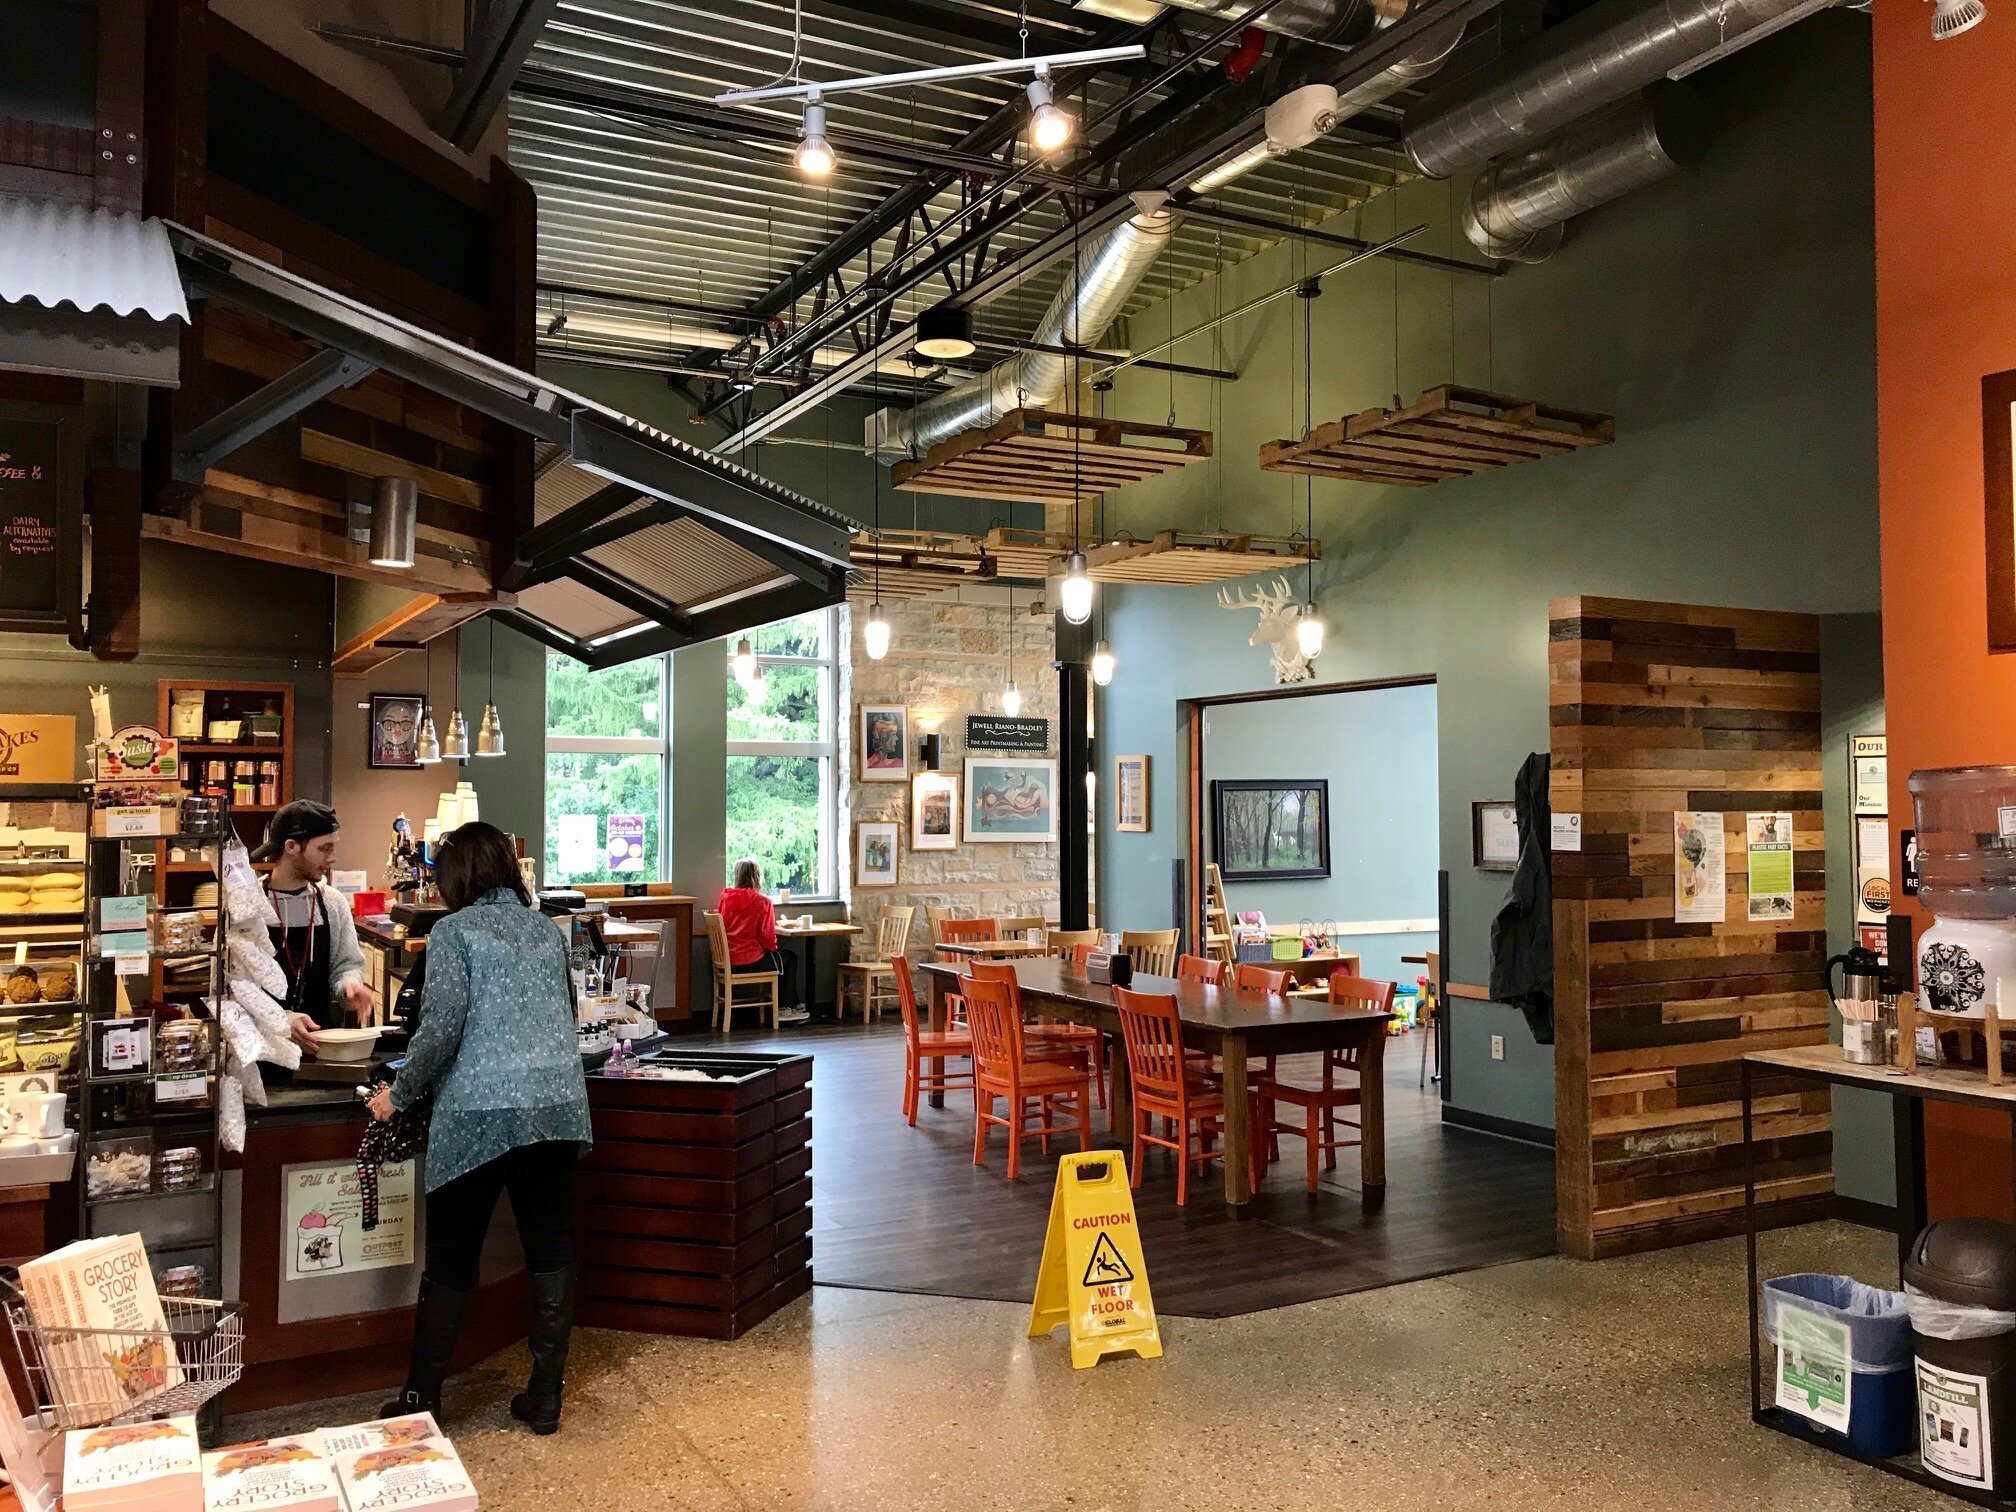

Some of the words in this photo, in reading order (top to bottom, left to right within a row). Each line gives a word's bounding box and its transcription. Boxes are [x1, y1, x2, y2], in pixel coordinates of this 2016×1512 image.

[972, 722, 993, 730] JEWELL
[994, 723, 1043, 732] RIANO-BRADLEY
[1857, 742, 1884, 752] OUR
[1907, 879, 1919, 887] RE
[1073, 1212, 1131, 1230] CAUTION
[83, 1249, 142, 1286] GROCERY
[38, 1277, 52, 1308] GROCERY
[51, 1274, 66, 1305] GROCERY
[69, 1270, 81, 1302] GROCERY
[98, 1272, 137, 1303] STORY
[1098, 1284, 1125, 1298] WET
[1091, 1299, 1134, 1315] FLOOR
[1923, 1382, 1969, 1405] LANDFILL
[212, 1484, 328, 1508] GROCERY
[358, 1483, 466, 1511] GROCERY
[376, 1478, 444, 1499] STORY
